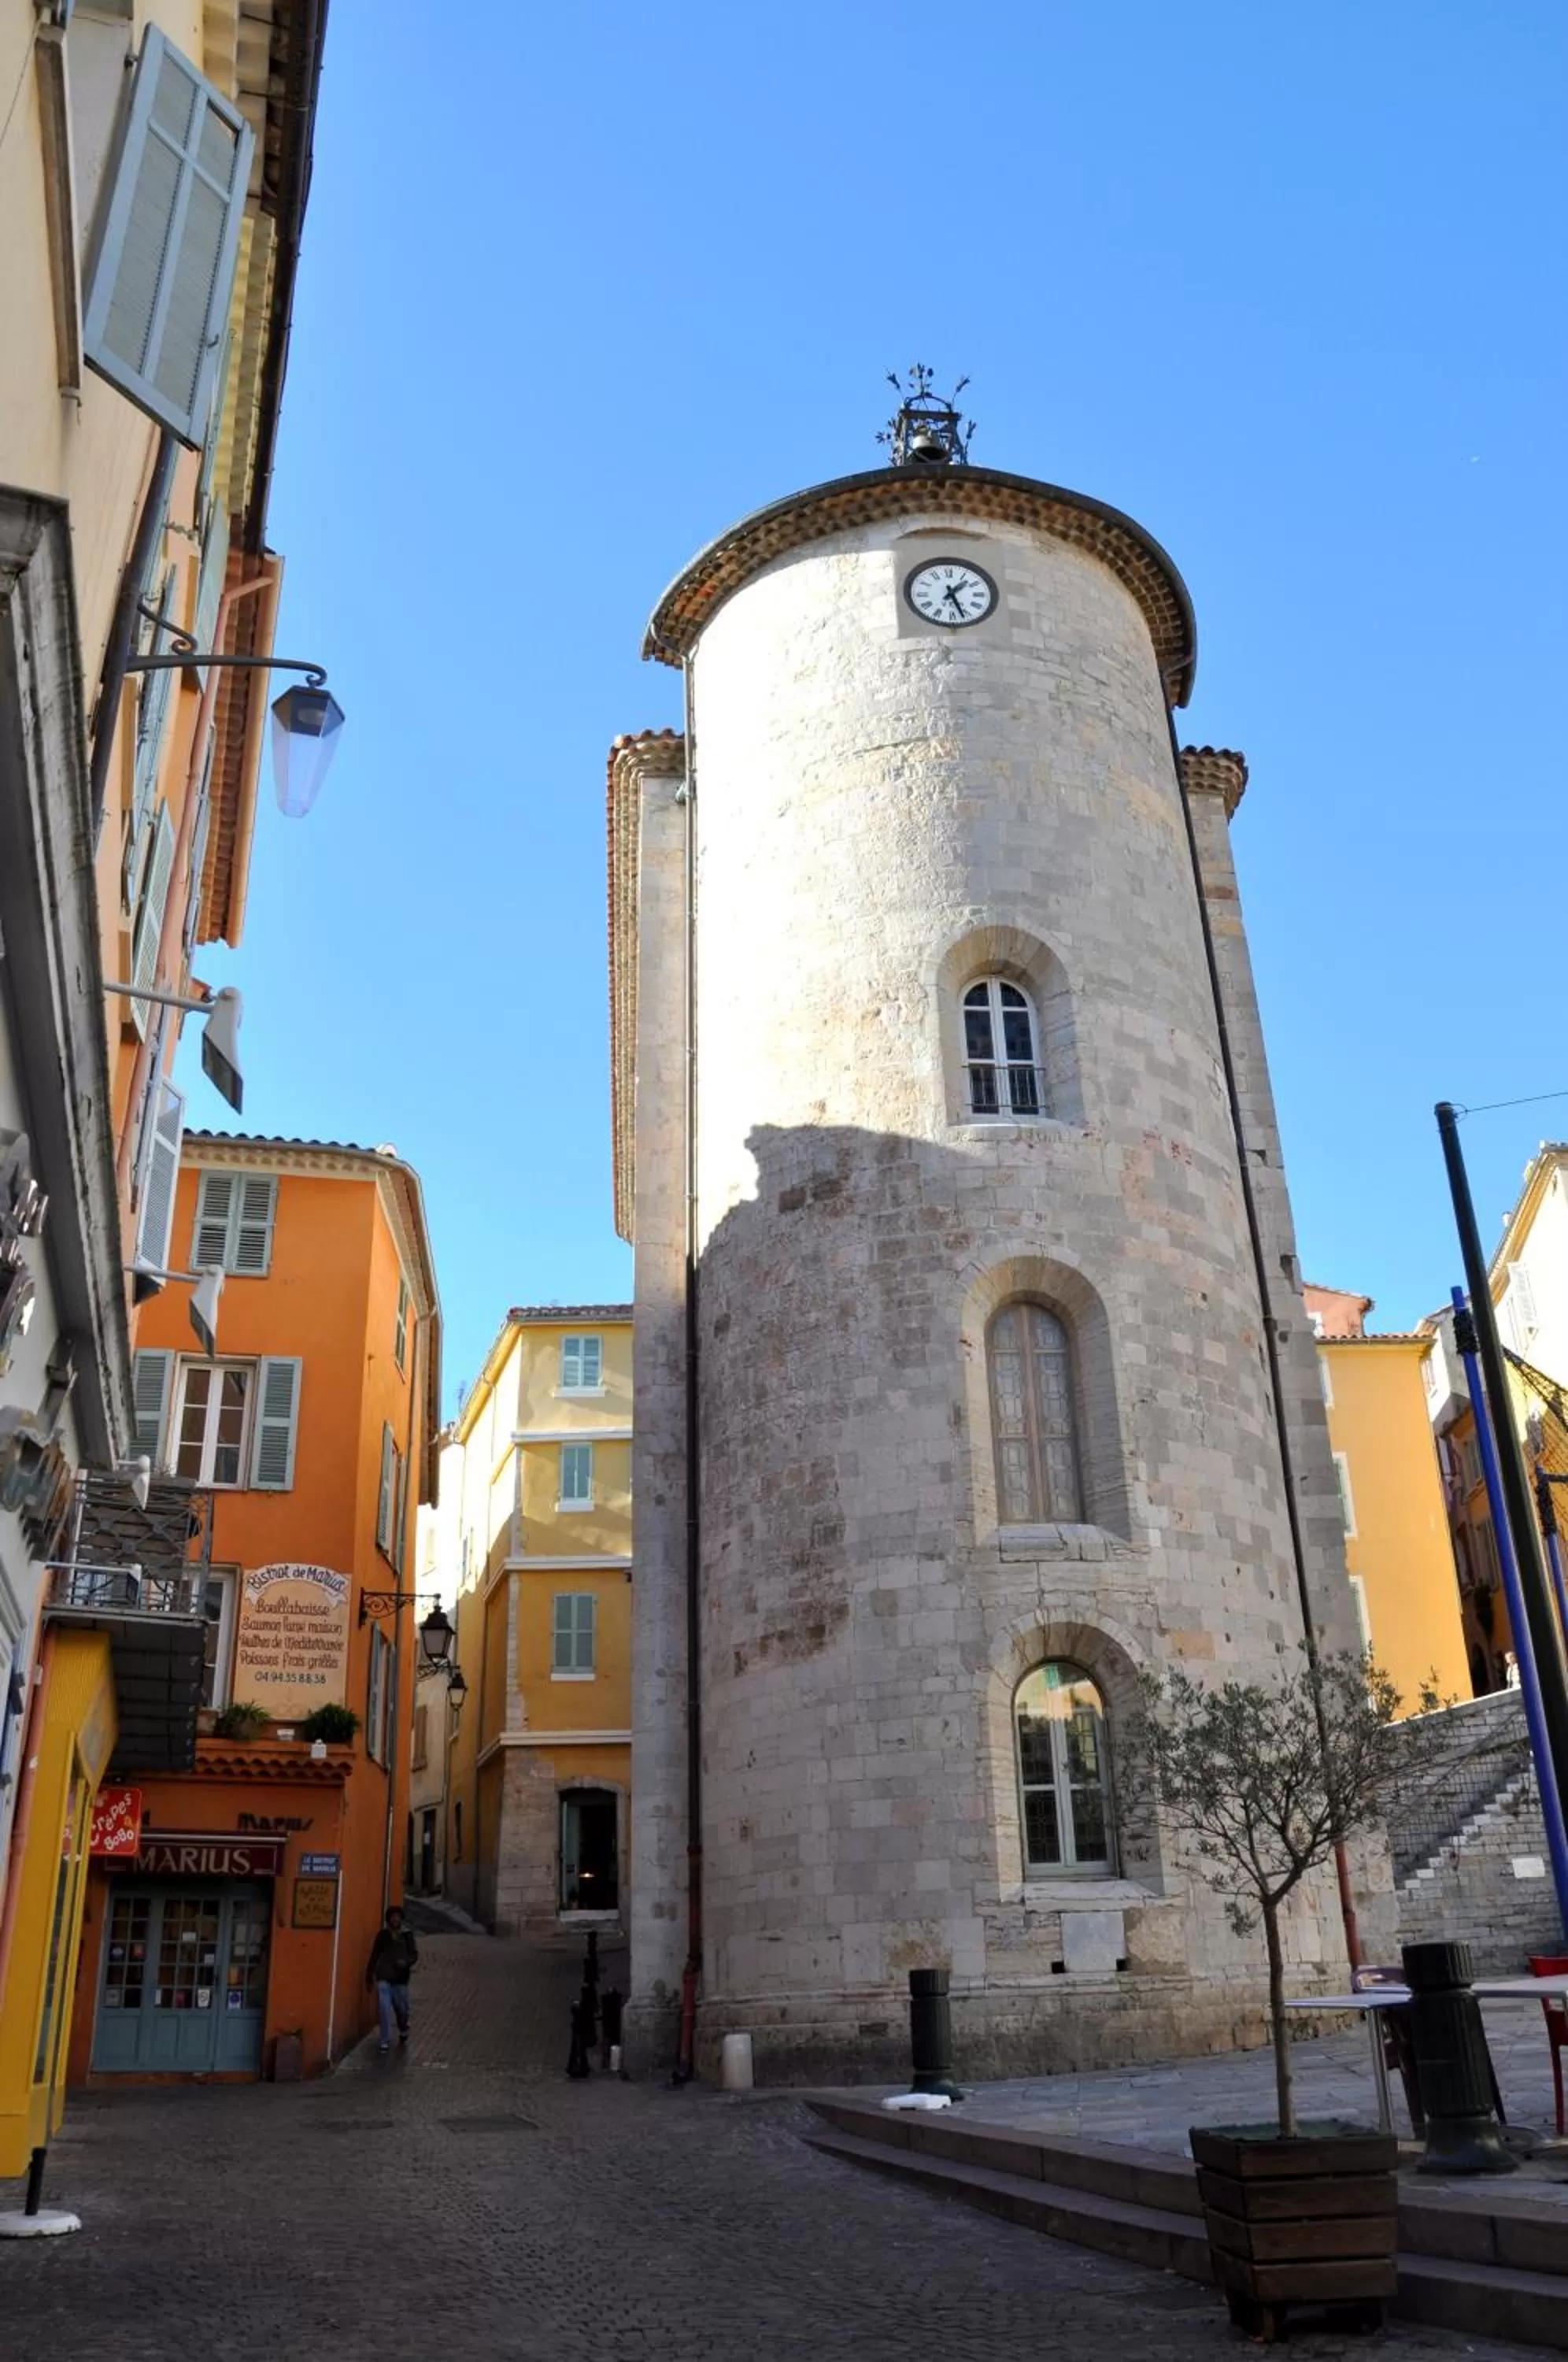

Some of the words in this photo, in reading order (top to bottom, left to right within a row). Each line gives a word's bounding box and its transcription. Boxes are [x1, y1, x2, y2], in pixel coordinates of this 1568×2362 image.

[247, 1565, 290, 1589] Bistrot
[292, 1565, 306, 1579] de
[306, 1567, 345, 1591] Marius
[132, 1847, 251, 1875] MARIUS
